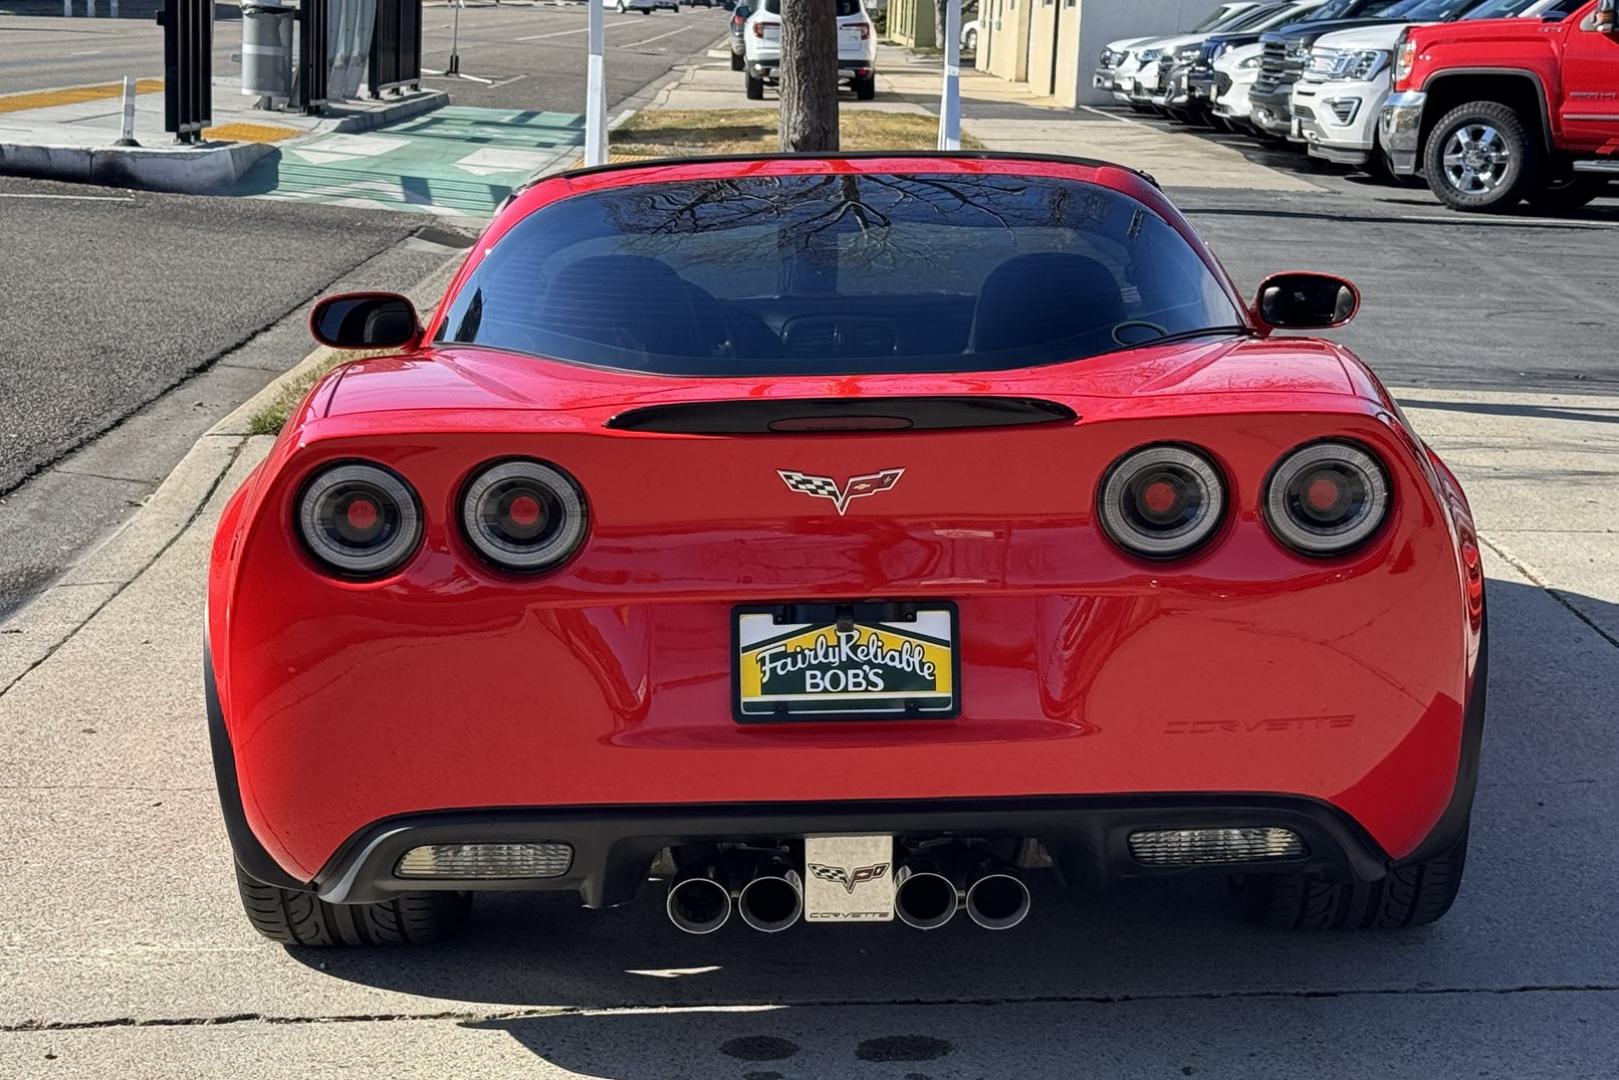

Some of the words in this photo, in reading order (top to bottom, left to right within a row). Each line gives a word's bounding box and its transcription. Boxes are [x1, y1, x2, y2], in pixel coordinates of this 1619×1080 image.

[758, 635, 840, 682] Fairly
[838, 630, 935, 679] Reliable
[805, 666, 884, 692] BOB'S
[1164, 715, 1355, 734] CORVETTE
